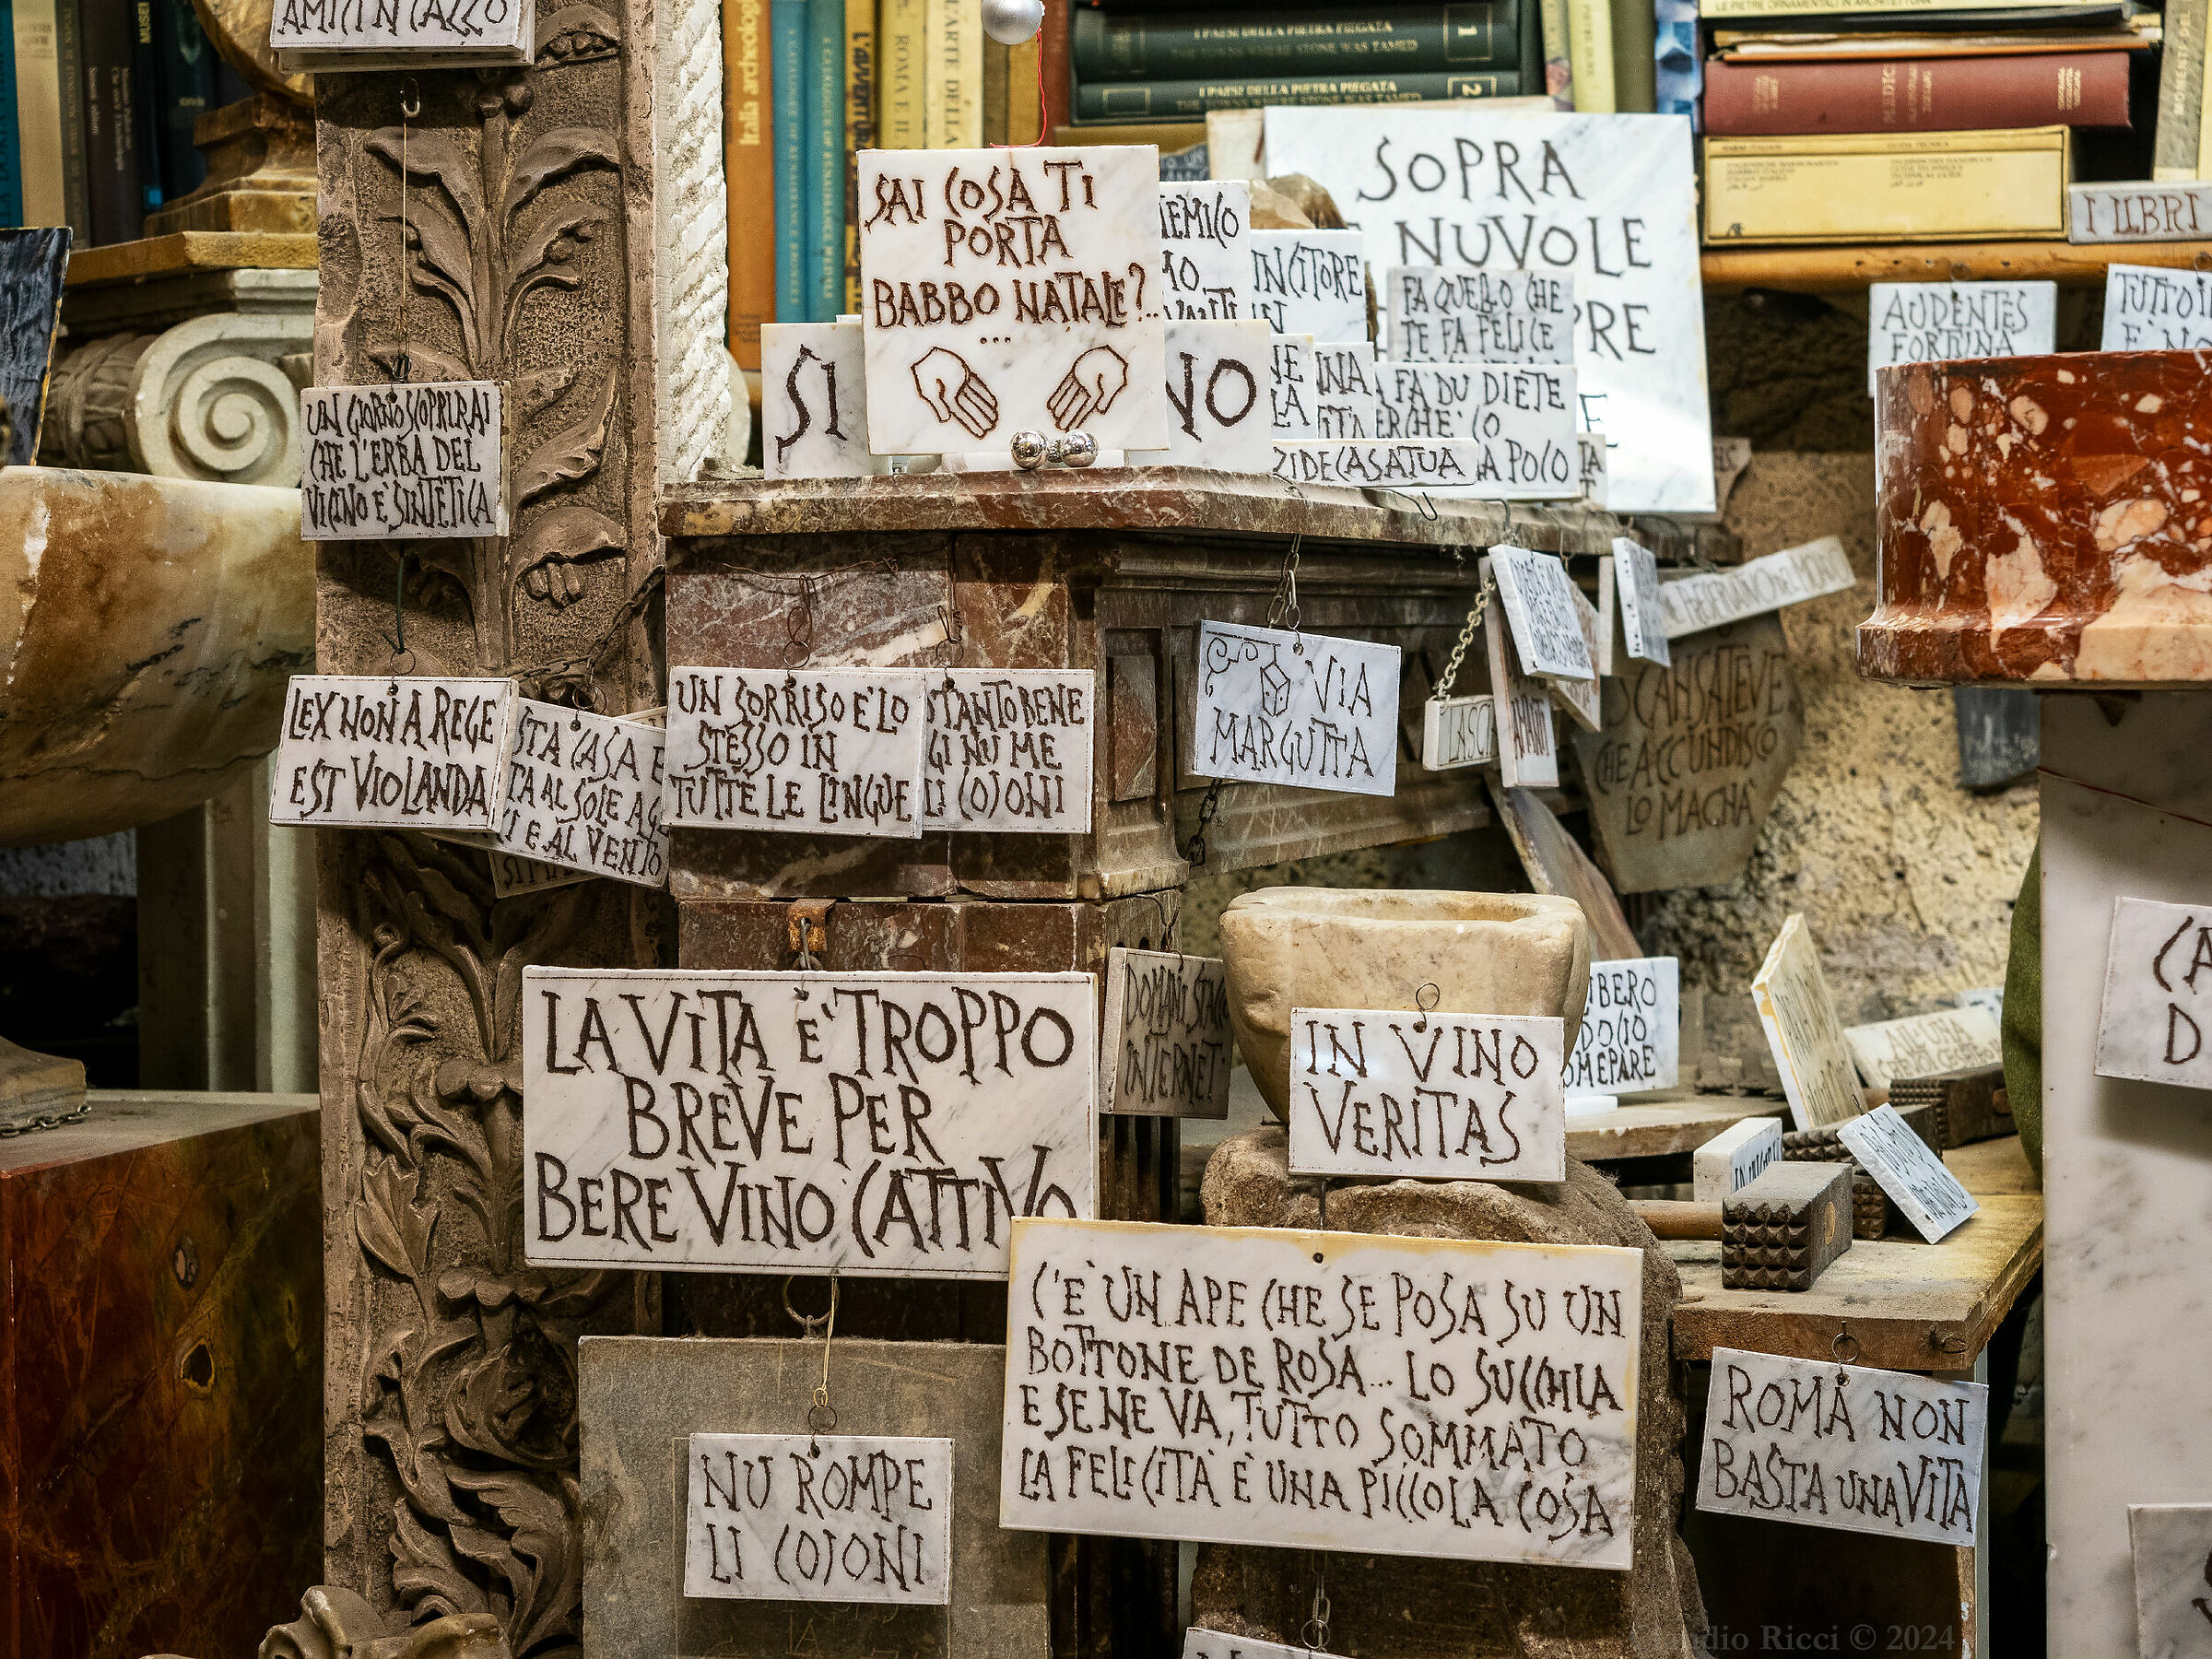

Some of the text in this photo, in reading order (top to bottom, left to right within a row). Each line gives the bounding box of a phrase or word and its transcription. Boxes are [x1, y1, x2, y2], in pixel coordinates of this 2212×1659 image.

[894, 35, 910, 93] ROMA
[739, 101, 761, 146] Italia
[945, 79, 960, 146] DELLA
[864, 159, 1099, 234] SAI COSA TI
[1356, 135, 1585, 205] SOPRA
[943, 214, 1074, 268] PORTA
[2083, 191, 2201, 235] I LIBRI
[1395, 215, 1652, 277] NUVOLE
[873, 278, 1001, 328] BABBO
[1402, 276, 1429, 315] FA
[1526, 272, 1563, 314] CHE
[1881, 288, 2028, 335] AUDENTES
[2114, 272, 2194, 319] TUTTO
[1401, 312, 1554, 358] TE FA FELICE
[1890, 327, 2017, 362] FORTUNA
[307, 387, 490, 441] UN GIORNO SCOPRIRAI
[775, 344, 848, 464] SI
[1166, 352, 1256, 442] NO
[1435, 370, 1566, 412] DU DIETE
[310, 434, 481, 483] CHE L'ERBA DEL
[1505, 438, 1569, 483] POCO
[305, 476, 495, 533] VICINO SINTETICA
[676, 675, 909, 735] UN SORRISO LO
[1018, 683, 1085, 729] BENE
[1305, 655, 1372, 718] VIA
[289, 687, 498, 756] LEX NON A REGE
[512, 705, 641, 783] STA CASA
[684, 720, 839, 777] STESSO IN
[960, 735, 1001, 767] NU
[1010, 731, 1062, 770] ME
[1209, 707, 1374, 778] MARGUTTA
[289, 749, 489, 820] EST VIOLANDA
[507, 761, 535, 808] TA
[540, 772, 568, 812] AL
[556, 777, 624, 828] SOLE
[669, 766, 912, 827] TUTTE LE LINGUE
[924, 778, 947, 818] LI
[1627, 795, 1653, 836] LO
[524, 819, 541, 850] E
[542, 824, 578, 863] AL
[585, 824, 663, 877] VENTO
[542, 986, 1076, 1086] LA VITA TROPPO
[1305, 1020, 1539, 1087] IN VINO
[2163, 1002, 2202, 1065] D
[1125, 1029, 1225, 1106] INTERNET
[623, 1072, 945, 1171] BREVE PER
[1303, 1080, 1522, 1168] VERITAS
[535, 1144, 1078, 1259] BERE VINO CATTIVO
[1102, 1265, 1626, 1347] UN APE CHE SE POSA SU UN
[1027, 1324, 1199, 1384] BOTTONE
[1212, 1345, 1265, 1390] DE
[1406, 1349, 1455, 1401] LO
[1465, 1347, 1624, 1417] SUCCHIA
[1019, 1384, 1041, 1427] E
[1044, 1382, 1093, 1441] SE
[1099, 1385, 1155, 1440] NE
[1230, 1390, 1359, 1449] TUTTO
[1371, 1406, 1587, 1474] SOMMATO
[1722, 1364, 1971, 1446] ROMA NON
[700, 1449, 933, 1523] NU ROMPE
[1018, 1445, 1614, 1544] LA UNA PICCOLA COSA
[1712, 1438, 1973, 1534] BASTA UNA VITA
[706, 1523, 744, 1584] LI
